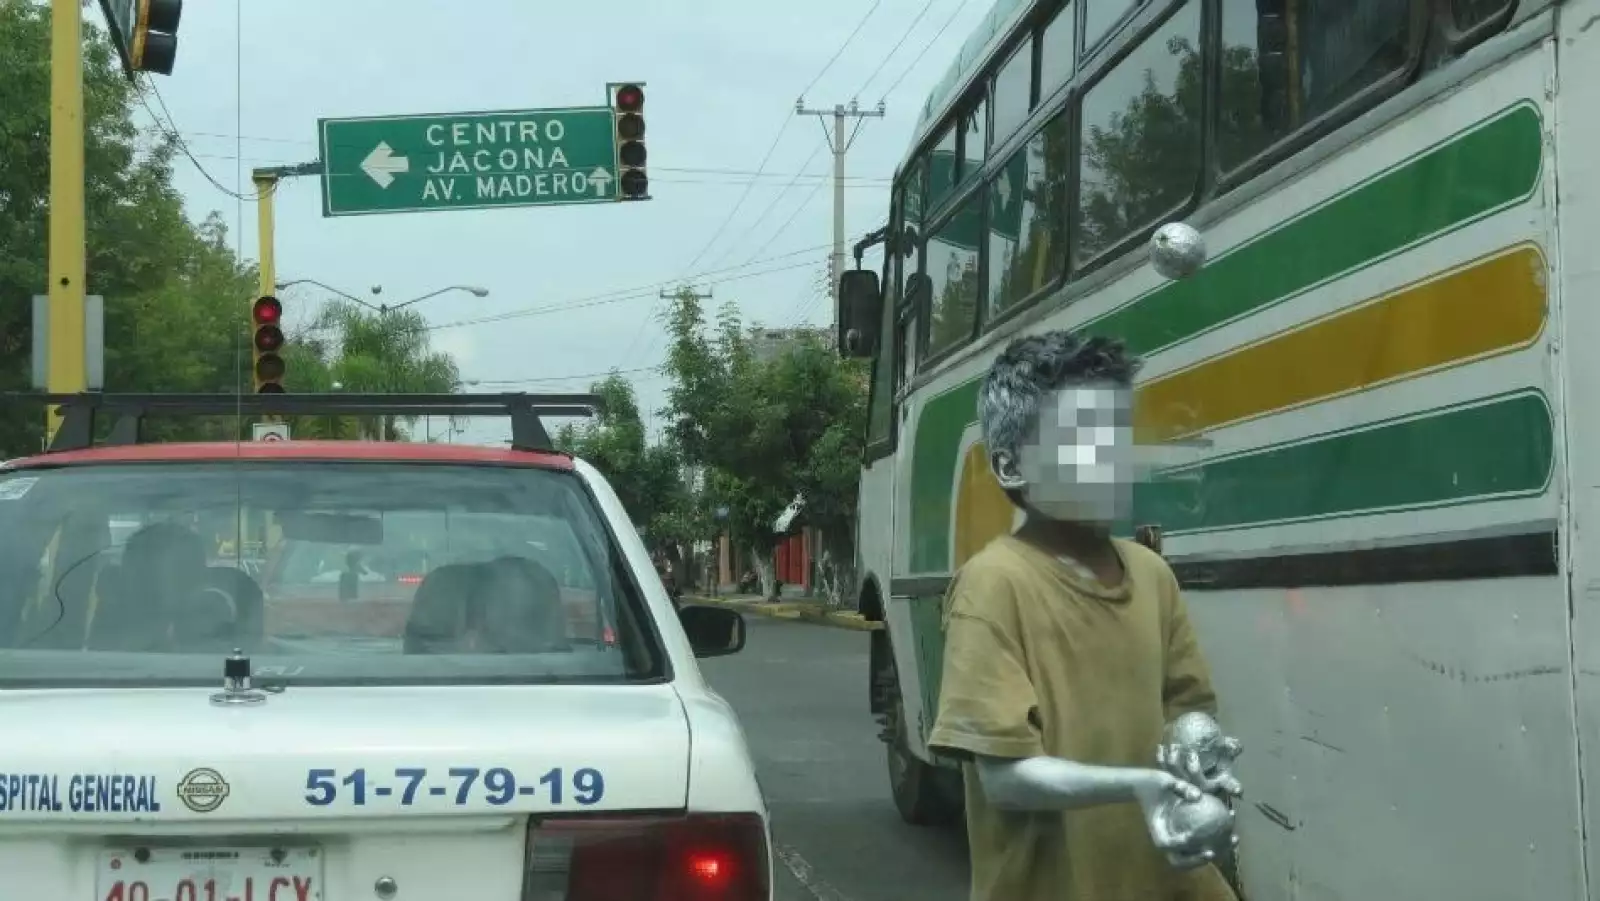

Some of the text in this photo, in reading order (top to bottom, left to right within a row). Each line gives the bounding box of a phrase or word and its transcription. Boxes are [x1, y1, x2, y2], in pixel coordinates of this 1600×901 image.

[426, 119, 565, 146] CENTRO
[426, 146, 569, 174] JACONA
[422, 171, 587, 201] AV. MADERO
[68, 774, 160, 812] GENERAL
[305, 767, 604, 806] 51-7-79-19
